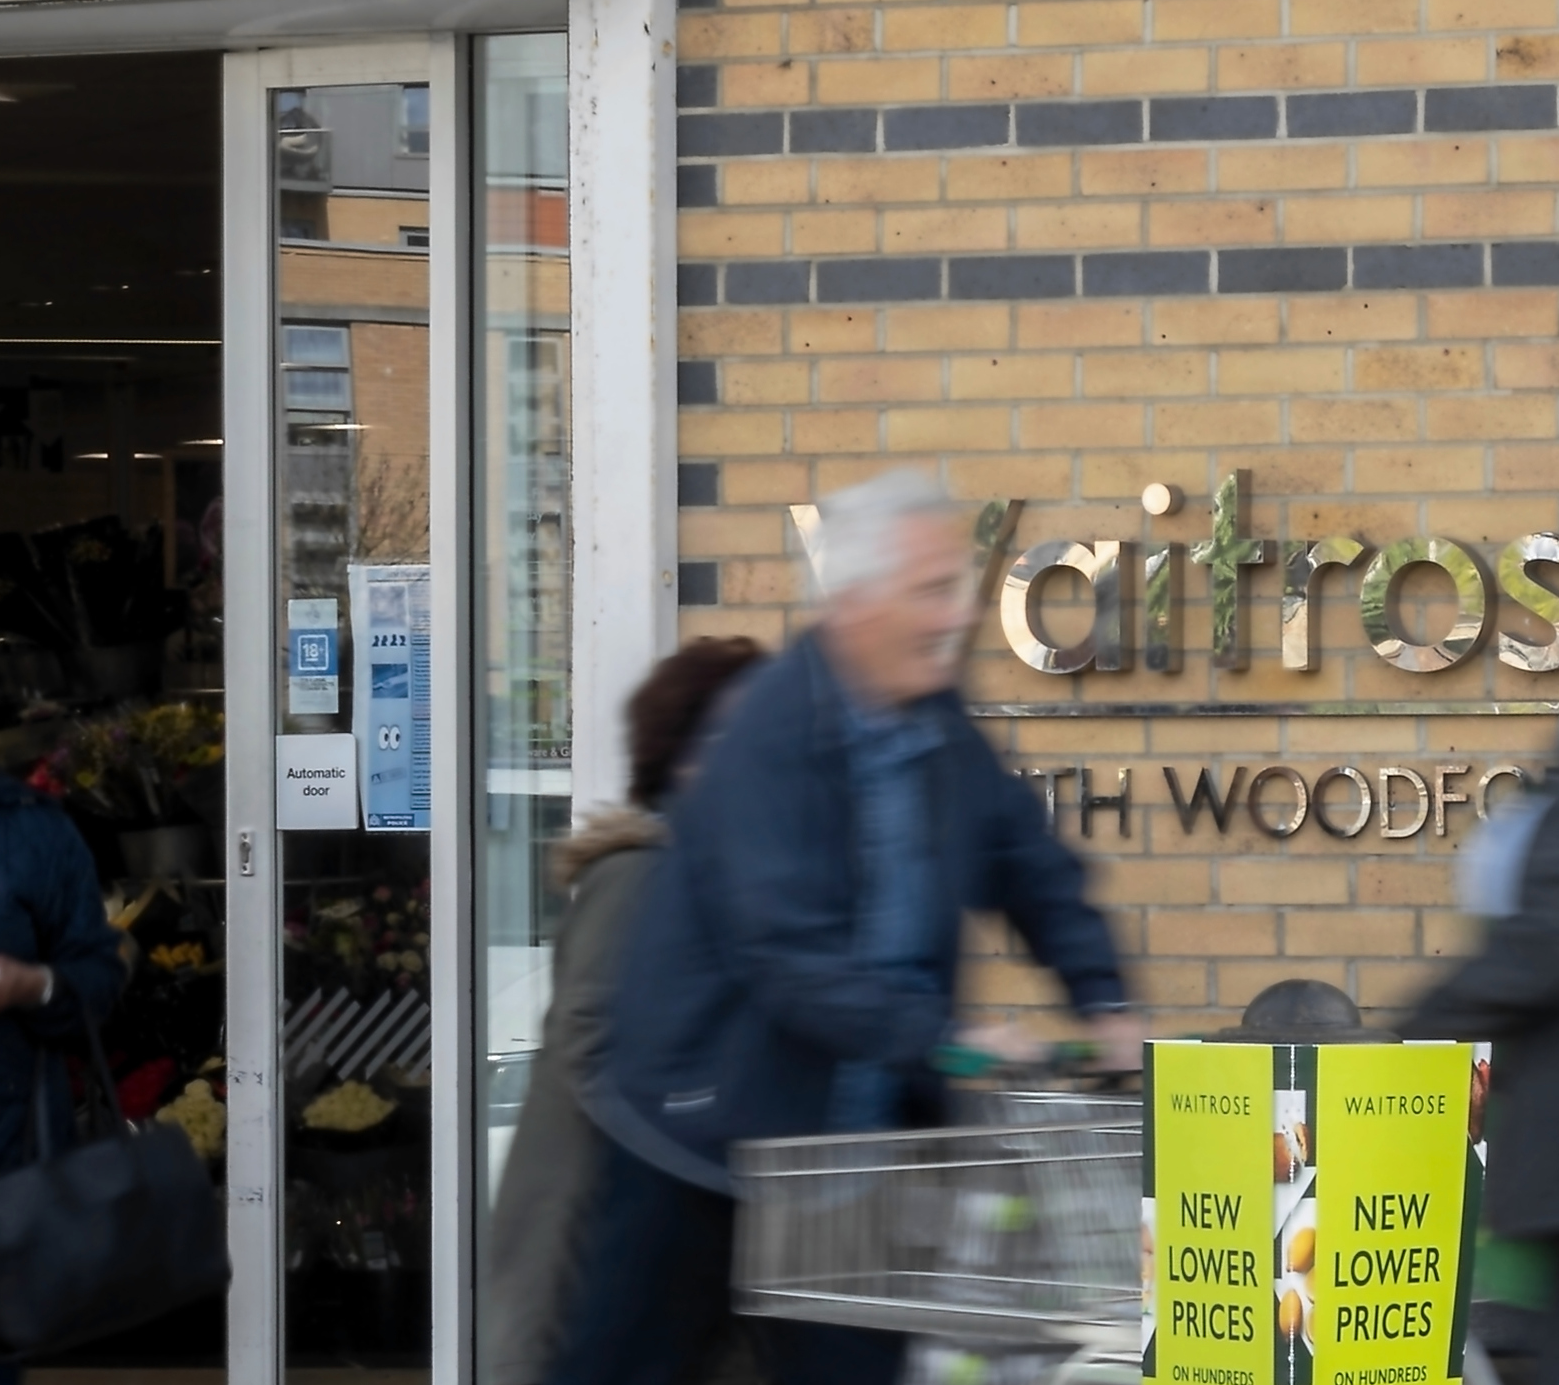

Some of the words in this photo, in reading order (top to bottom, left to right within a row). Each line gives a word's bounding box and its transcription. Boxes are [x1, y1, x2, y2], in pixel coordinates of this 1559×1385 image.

[286, 767, 346, 780] Automatic
[303, 785, 330, 797] door
[1171, 1093, 1251, 1116] WAITROSE
[1345, 1094, 1446, 1115] WAITROSE
[1181, 1191, 1242, 1230] NEW
[1354, 1193, 1430, 1232] NEW
[1169, 1246, 1259, 1287] LOWER
[1334, 1246, 1440, 1287] LOWER
[1173, 1300, 1254, 1342] PRICES
[1336, 1301, 1433, 1342] PRICES
[1173, 1365, 1189, 1381] ON
[1358, 1366, 1427, 1385] HUNDREDS
